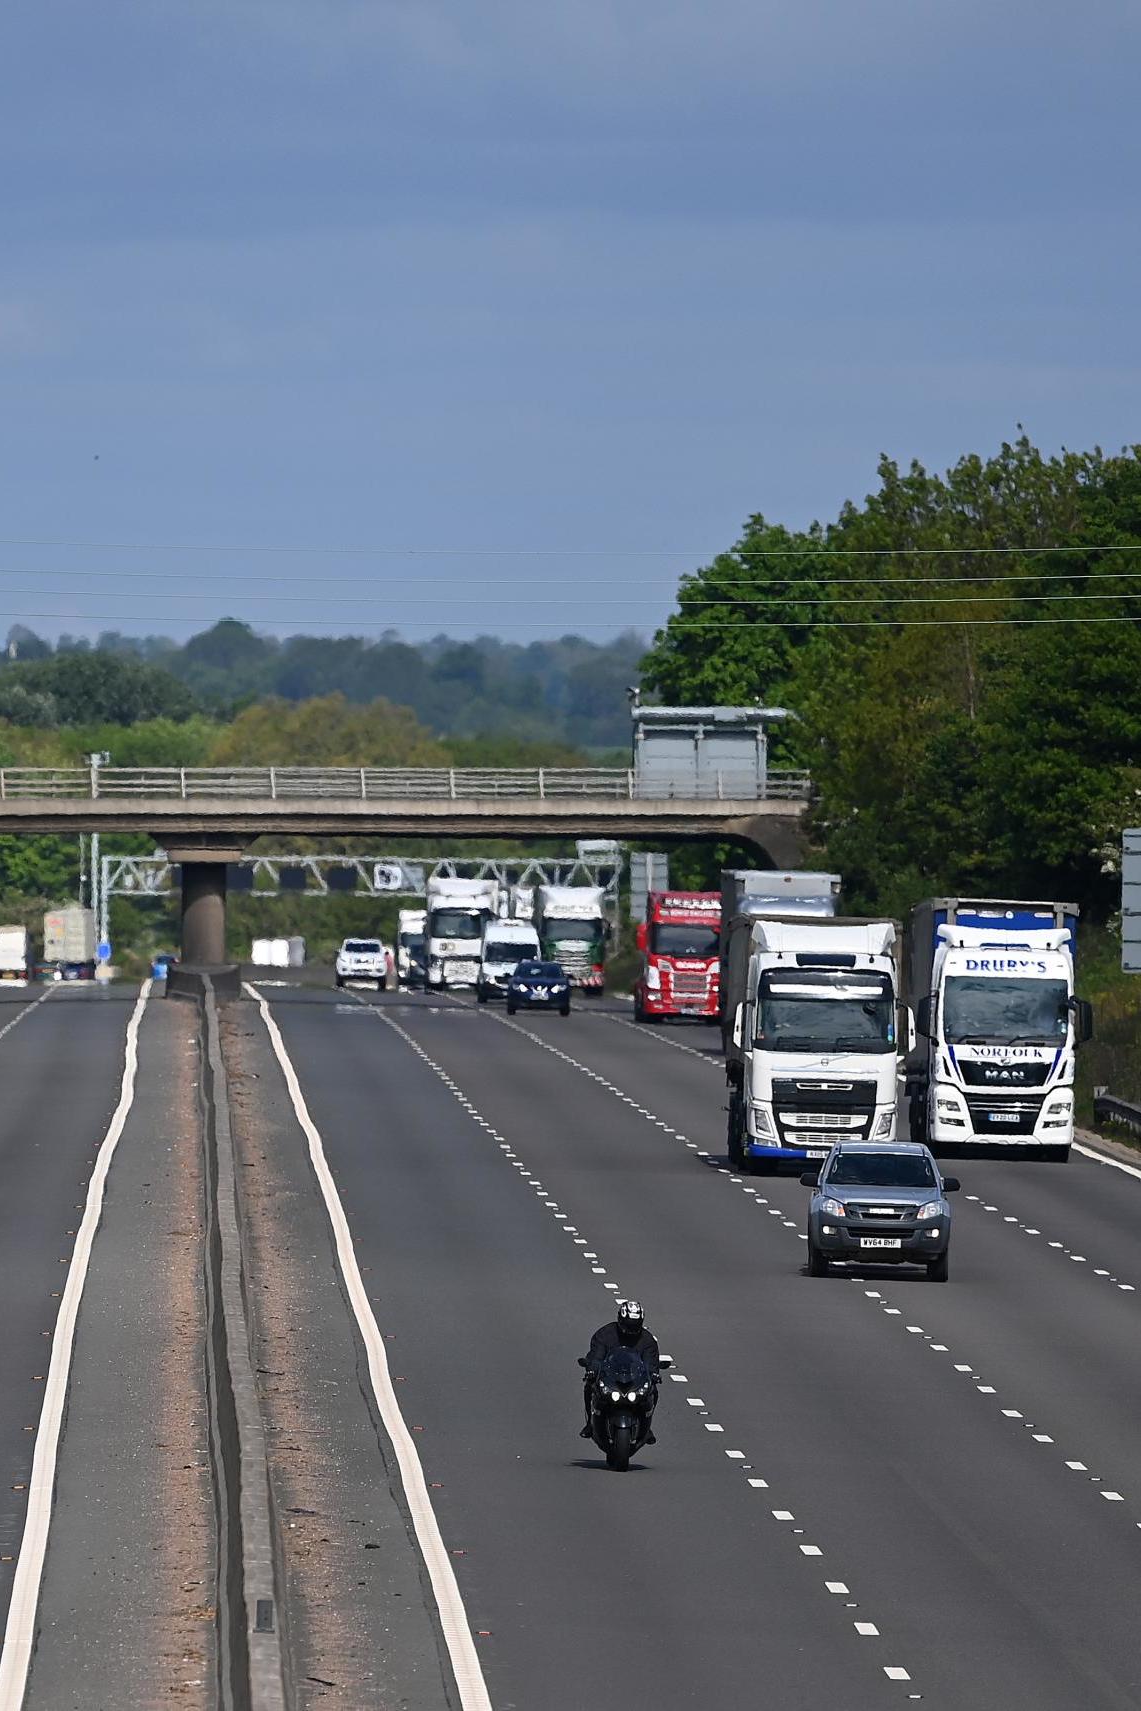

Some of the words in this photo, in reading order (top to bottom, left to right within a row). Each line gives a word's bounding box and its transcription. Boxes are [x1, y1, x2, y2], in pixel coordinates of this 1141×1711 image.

[966, 959, 1047, 974] DRURY'S
[971, 1047, 1043, 1058] NORFOLK
[985, 1070, 1025, 1080] MAN
